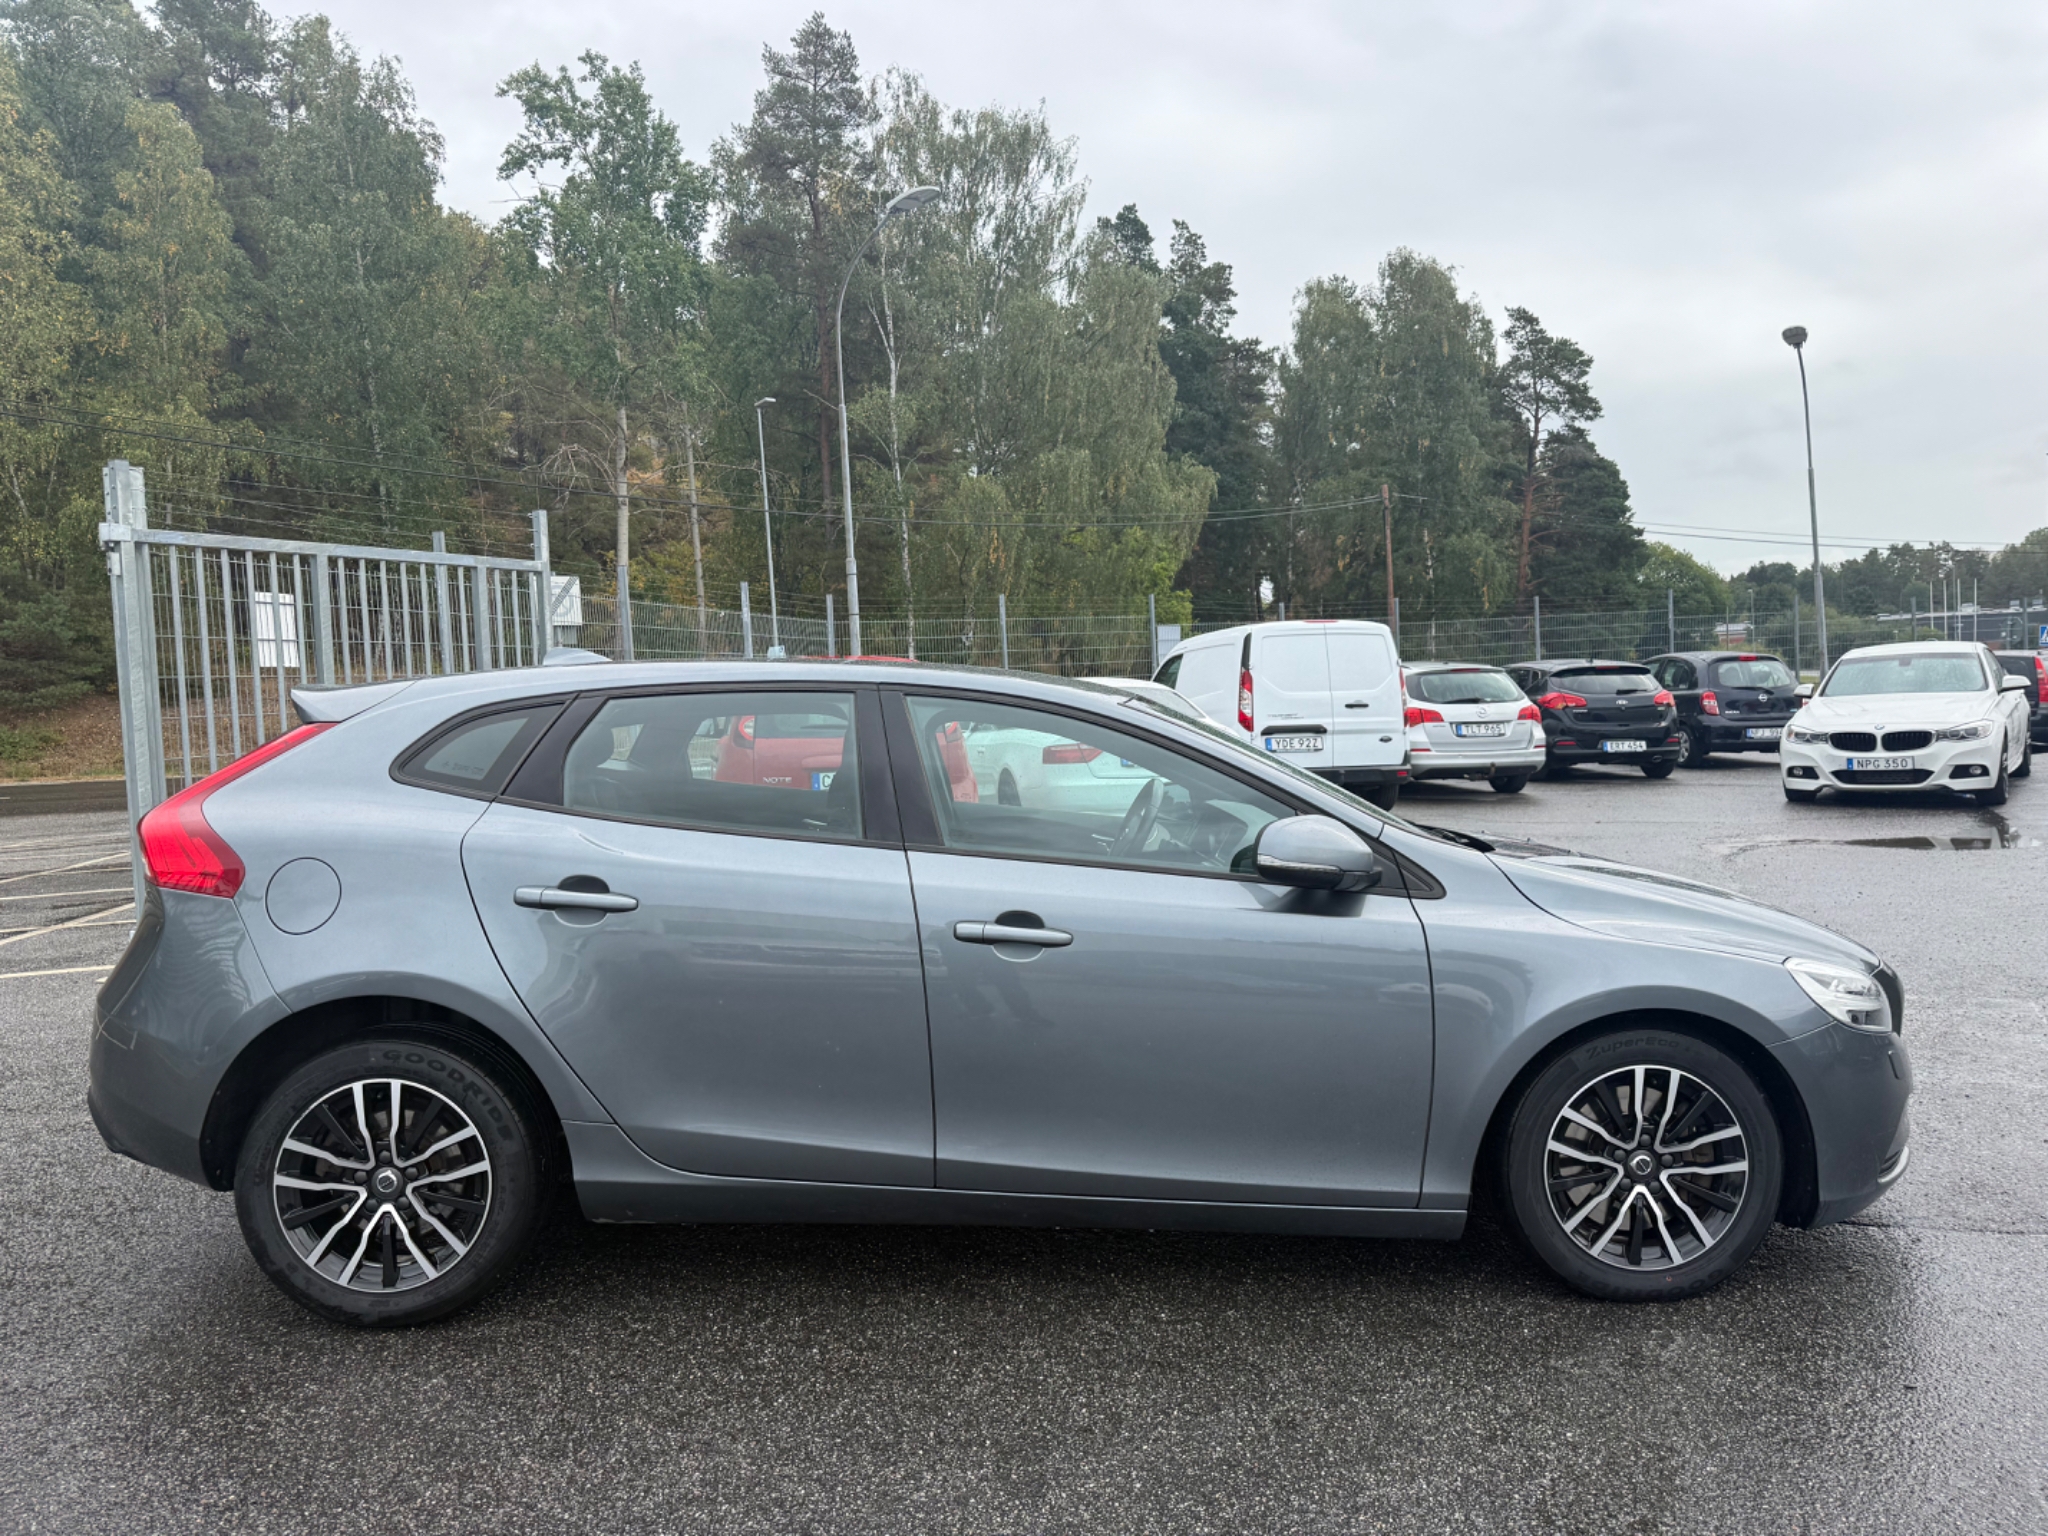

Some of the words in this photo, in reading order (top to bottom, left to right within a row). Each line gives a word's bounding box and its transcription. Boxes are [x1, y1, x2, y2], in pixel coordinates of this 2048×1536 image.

[1464, 725, 1483, 734] TLT
[1484, 723, 1501, 733] 965
[1610, 742, 1626, 750] ERT
[1627, 742, 1643, 750] 454
[1856, 759, 1880, 769] NPG
[1883, 758, 1908, 768] 350
[762, 776, 793, 784] NOTE
[1585, 1036, 1680, 1060] ZuperEco
